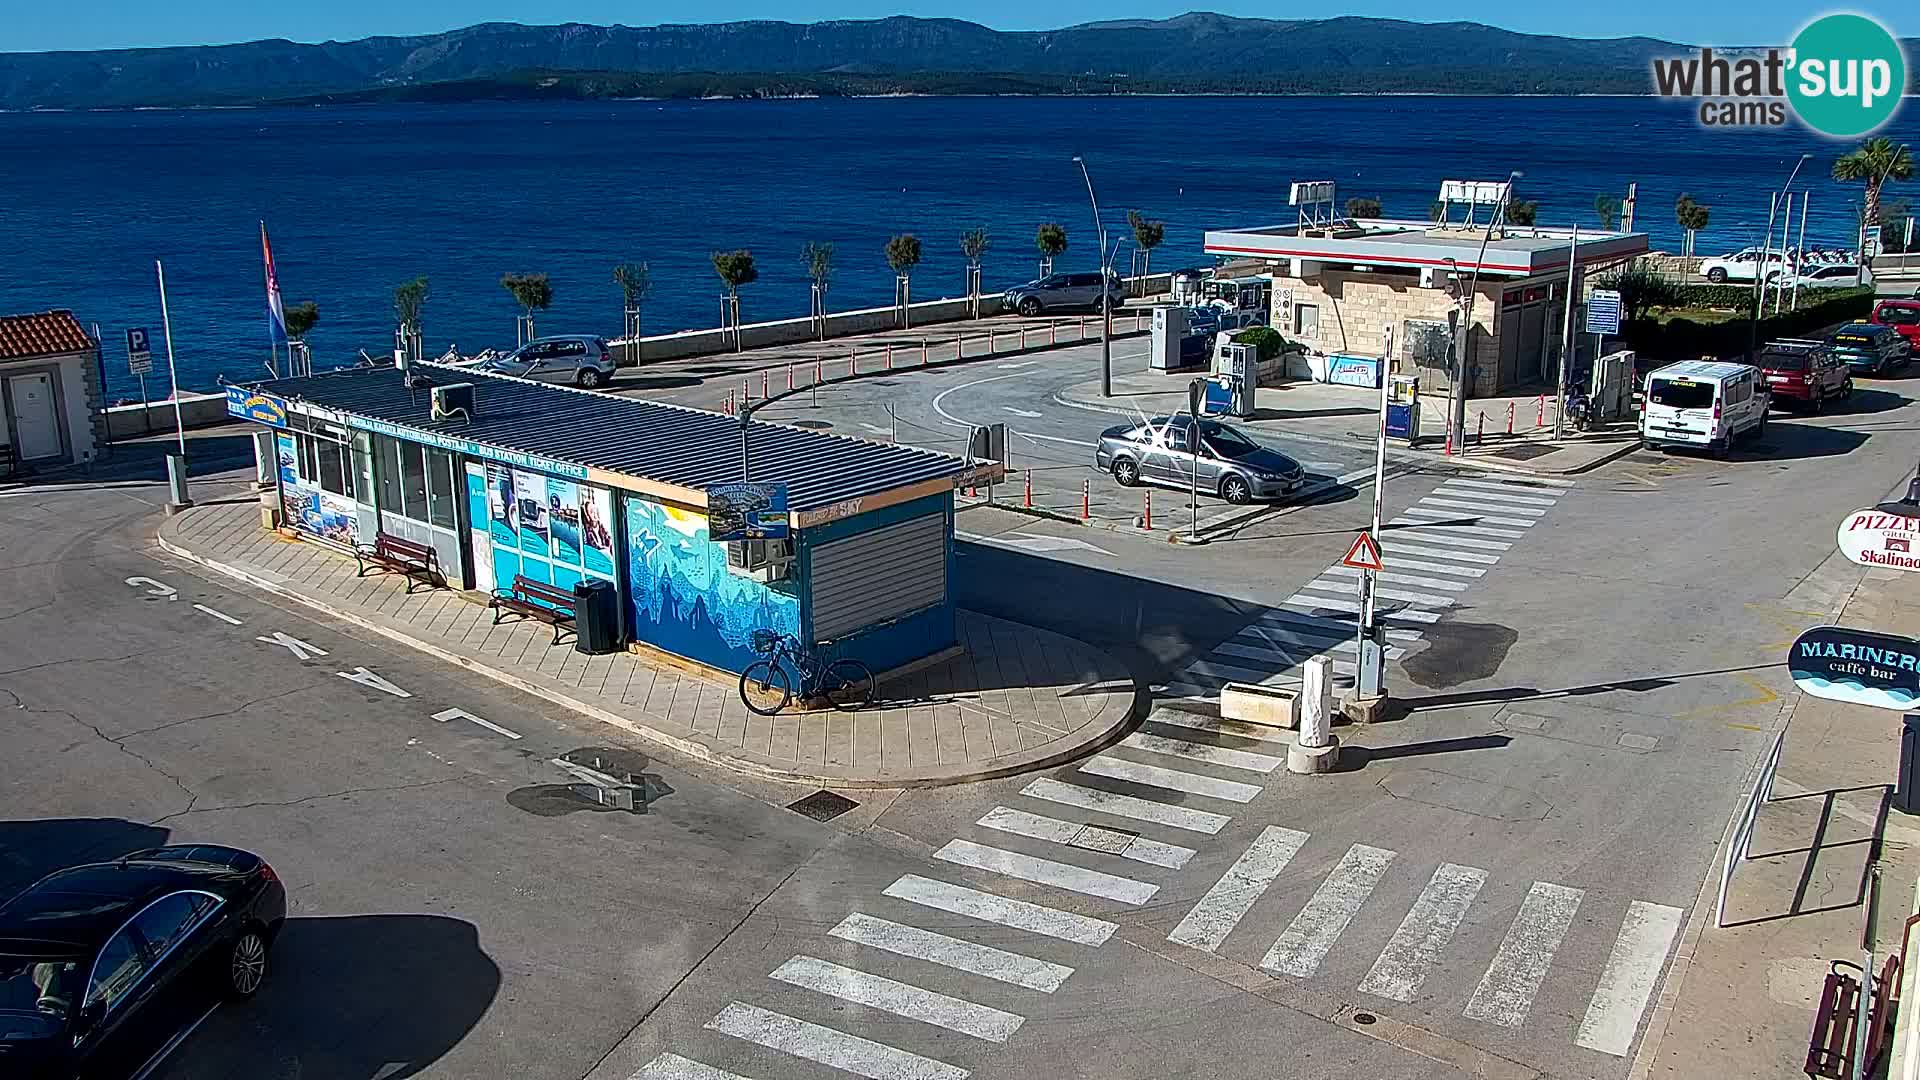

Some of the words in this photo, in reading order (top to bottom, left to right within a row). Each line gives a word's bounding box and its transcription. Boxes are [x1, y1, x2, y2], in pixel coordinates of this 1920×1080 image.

[131, 331, 144, 349] P
[480, 445, 494, 458] BUS
[494, 449, 528, 465] STATION
[528, 455, 555, 471] TICKET
[556, 462, 583, 477] OFFICE
[1848, 515, 1920, 533] PIZZE
[1882, 530, 1917, 540] GRILL
[1800, 641, 1920, 674] MARINER
[1829, 662, 1865, 675] caffe
[1870, 665, 1897, 680] bar
